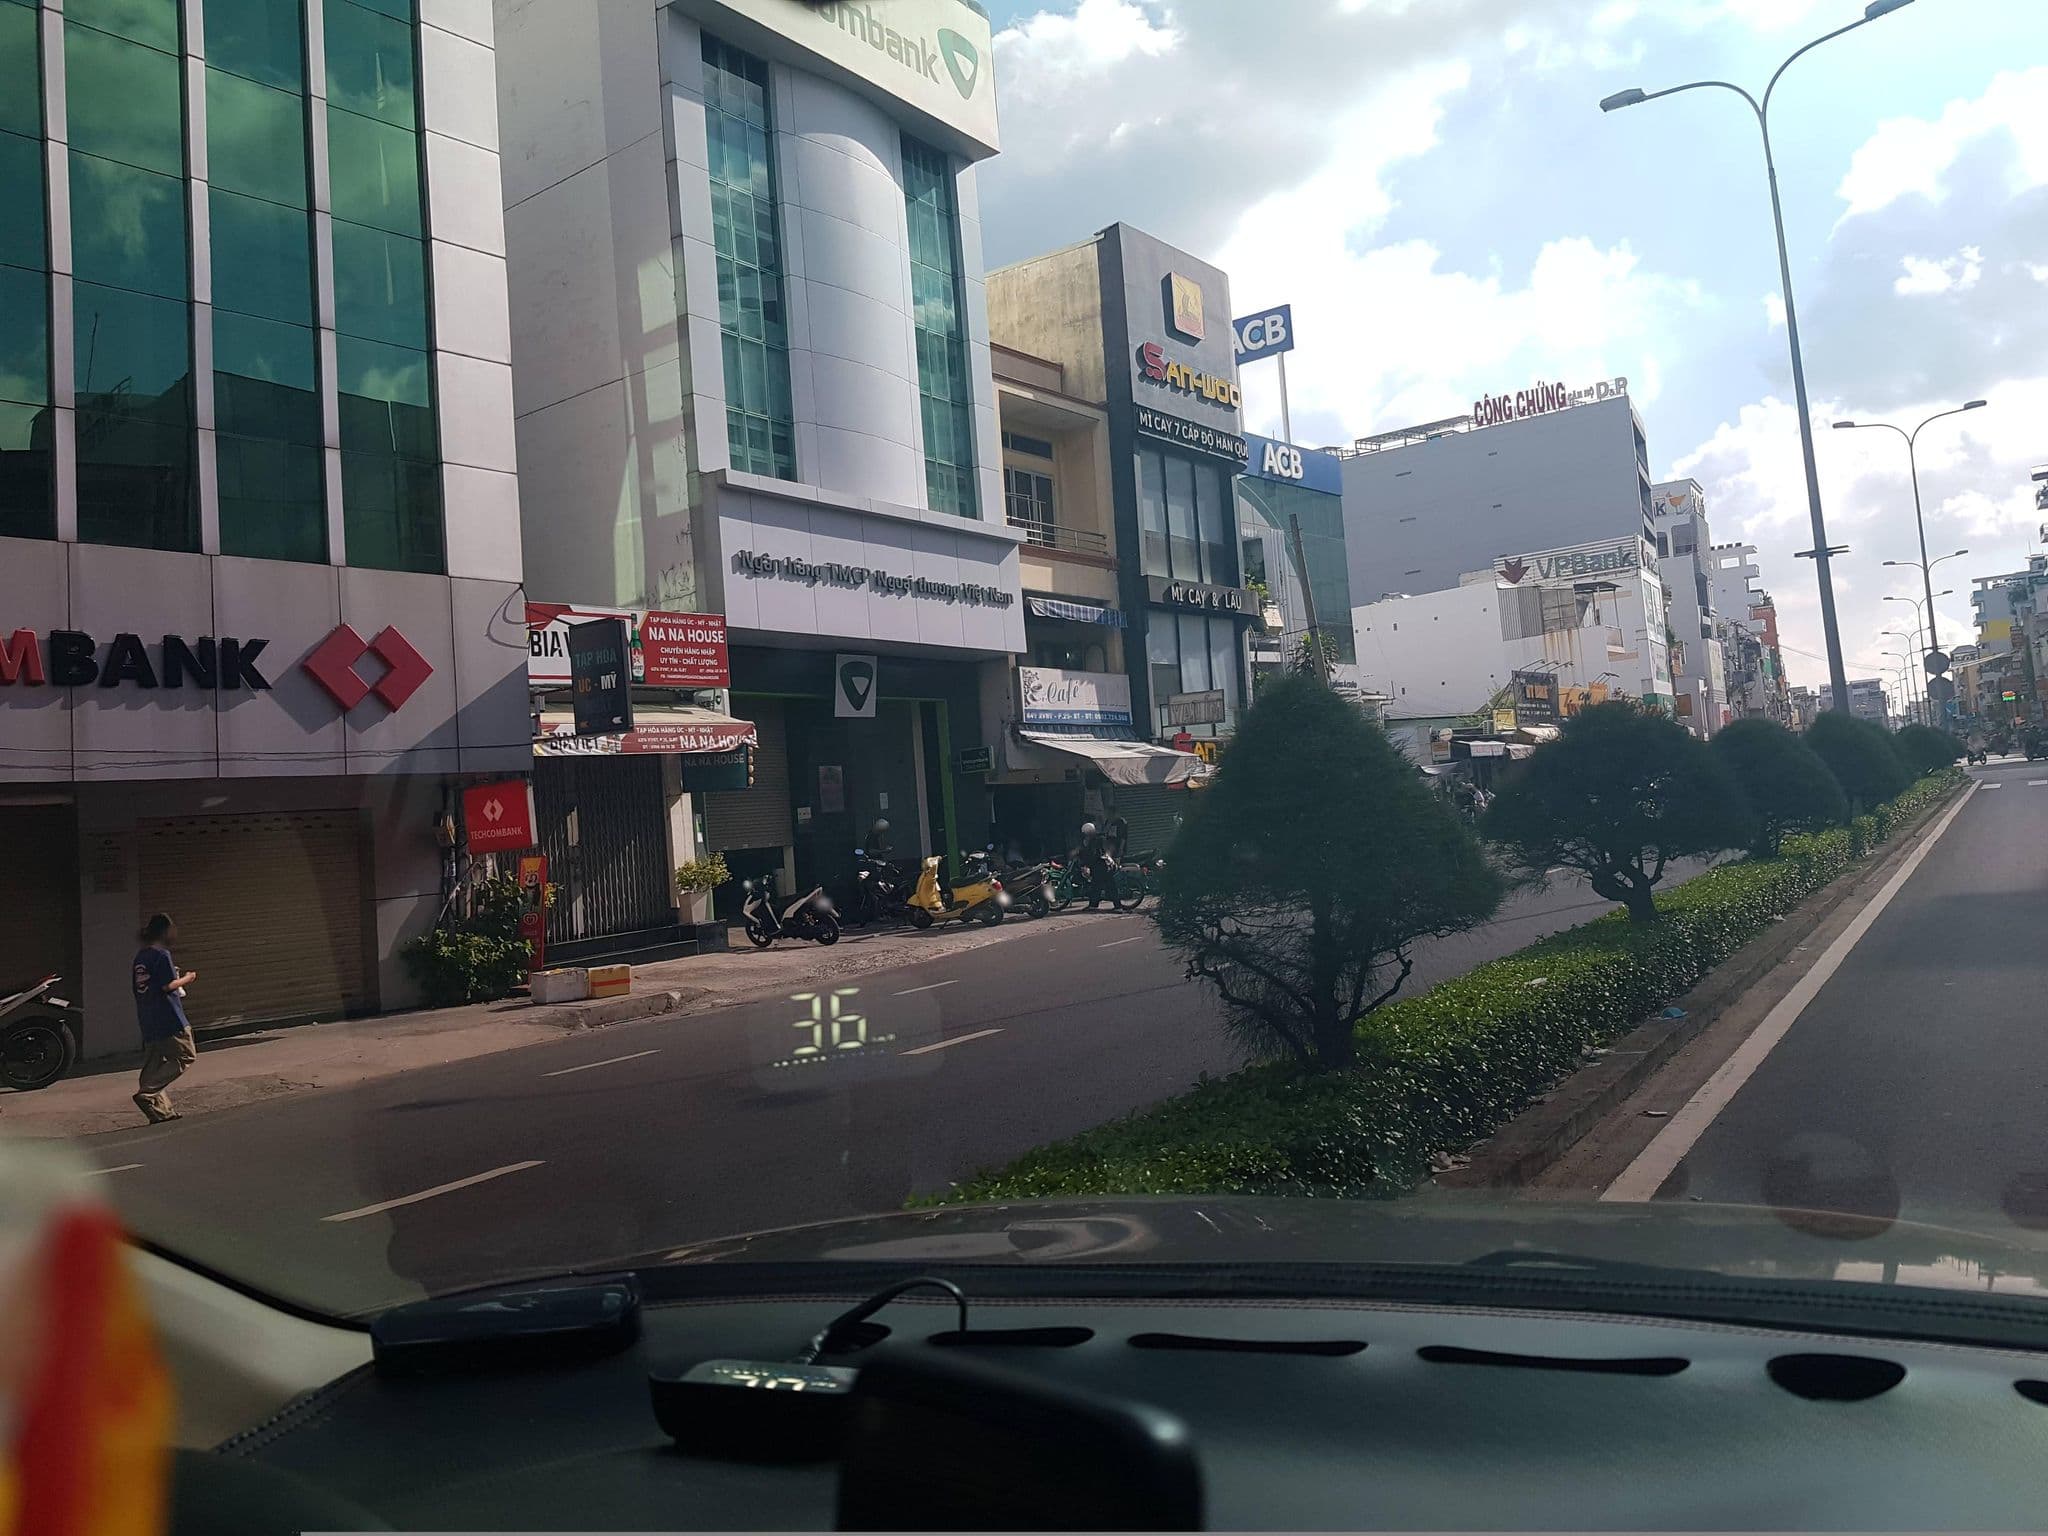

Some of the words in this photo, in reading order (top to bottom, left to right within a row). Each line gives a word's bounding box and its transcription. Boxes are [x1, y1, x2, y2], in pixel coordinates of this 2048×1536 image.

[1474, 393, 1513, 427] CÔNG
[1515, 381, 1567, 418] CHỨNG
[1139, 409, 1152, 428] MÌ
[1154, 416, 1172, 433] CAY
[1174, 422, 1180, 436] 7
[1201, 430, 1214, 450] ĐỘ
[1263, 442, 1304, 480] ACB
[736, 550, 781, 578] Ngân
[783, 557, 823, 585] hàng
[824, 563, 870, 588] TMCP
[874, 570, 913, 594] Ngoại
[961, 583, 986, 604] Việt
[986, 587, 1014, 606] Nam
[1171, 582, 1184, 602] MÌ
[1188, 588, 1206, 605] CAY
[1212, 591, 1219, 607] &
[529, 631, 563, 657] BIA
[648, 626, 666, 641] NA
[668, 627, 685, 642] NA
[687, 629, 725, 644] HOUSE
[680, 735, 697, 749] NA
[699, 735, 716, 748] NA
[713, 753, 745, 765] HOUSE
[471, 826, 523, 840] TECHCOMBANK
[790, 988, 867, 1055] 36
